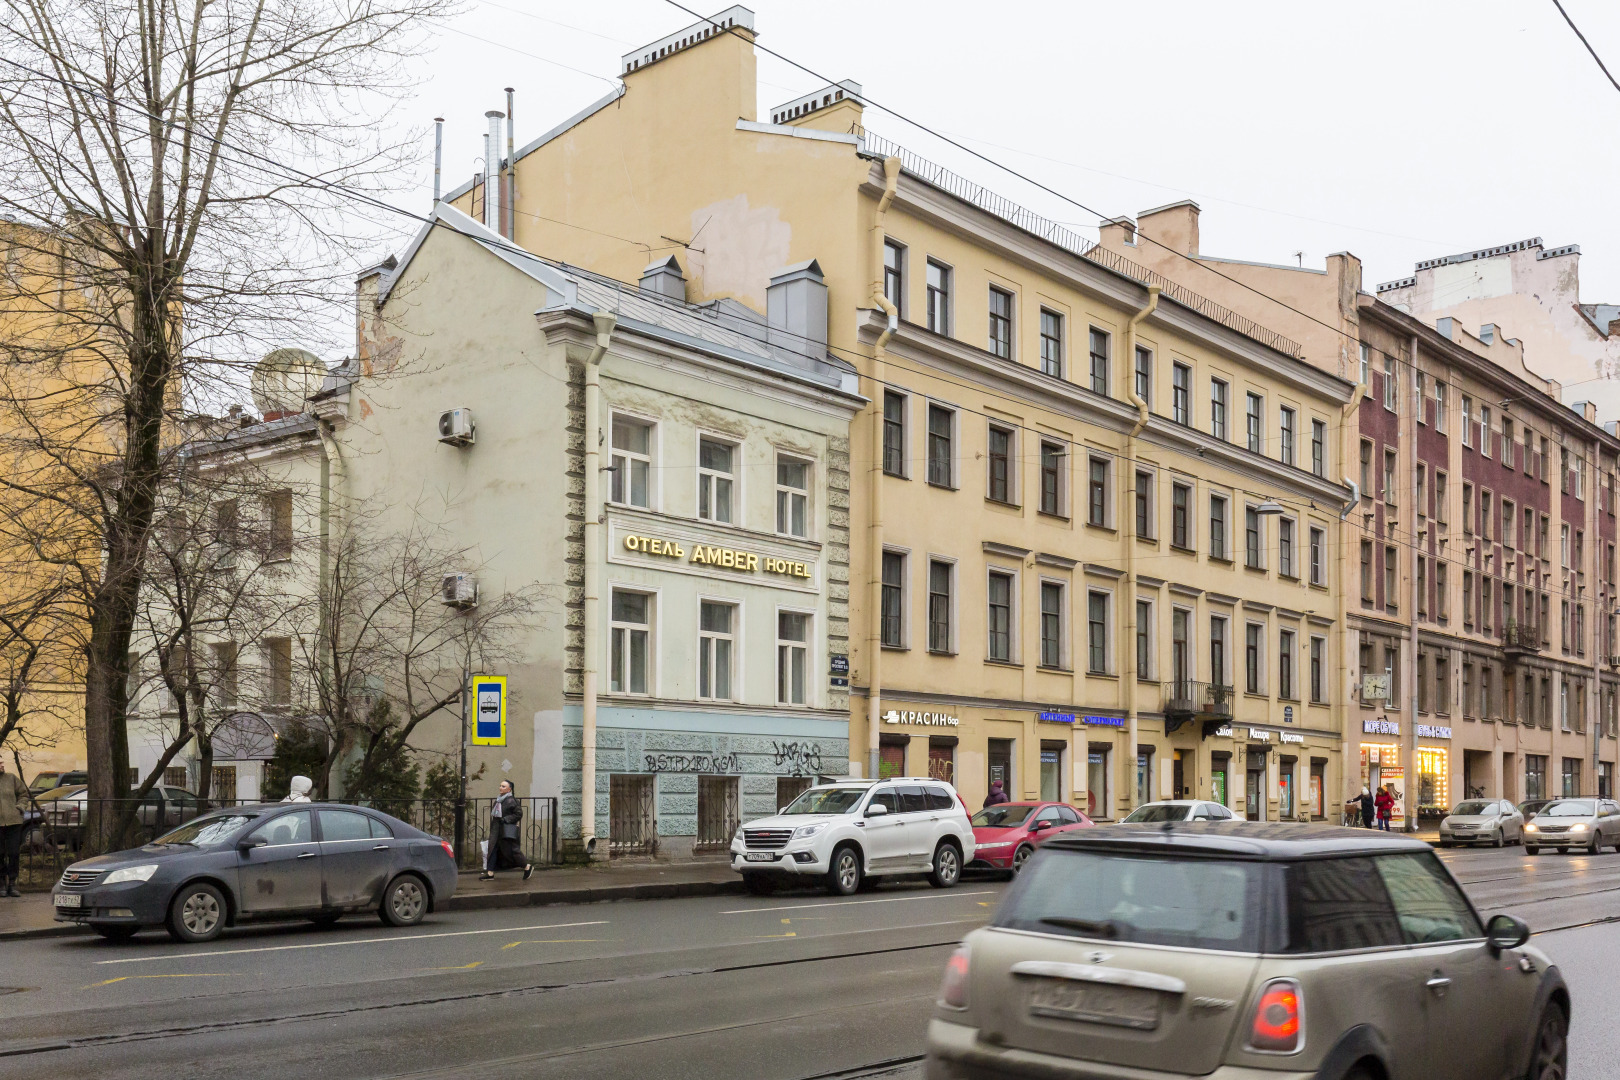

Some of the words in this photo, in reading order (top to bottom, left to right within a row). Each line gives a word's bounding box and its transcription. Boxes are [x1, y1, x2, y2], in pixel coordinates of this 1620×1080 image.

[623, 534, 685, 558] ОТЕЛЬ
[690, 545, 759, 572] AMBER
[763, 557, 812, 578] HOTEL
[900, 710, 947, 726] КРАСИН
[947, 716, 959, 726] бар
[1040, 712, 1075, 723] АНТЕННЫЙ
[1084, 715, 1125, 726] СУПЕРМАРКЕТ
[1364, 720, 1380, 733] МОРЕ
